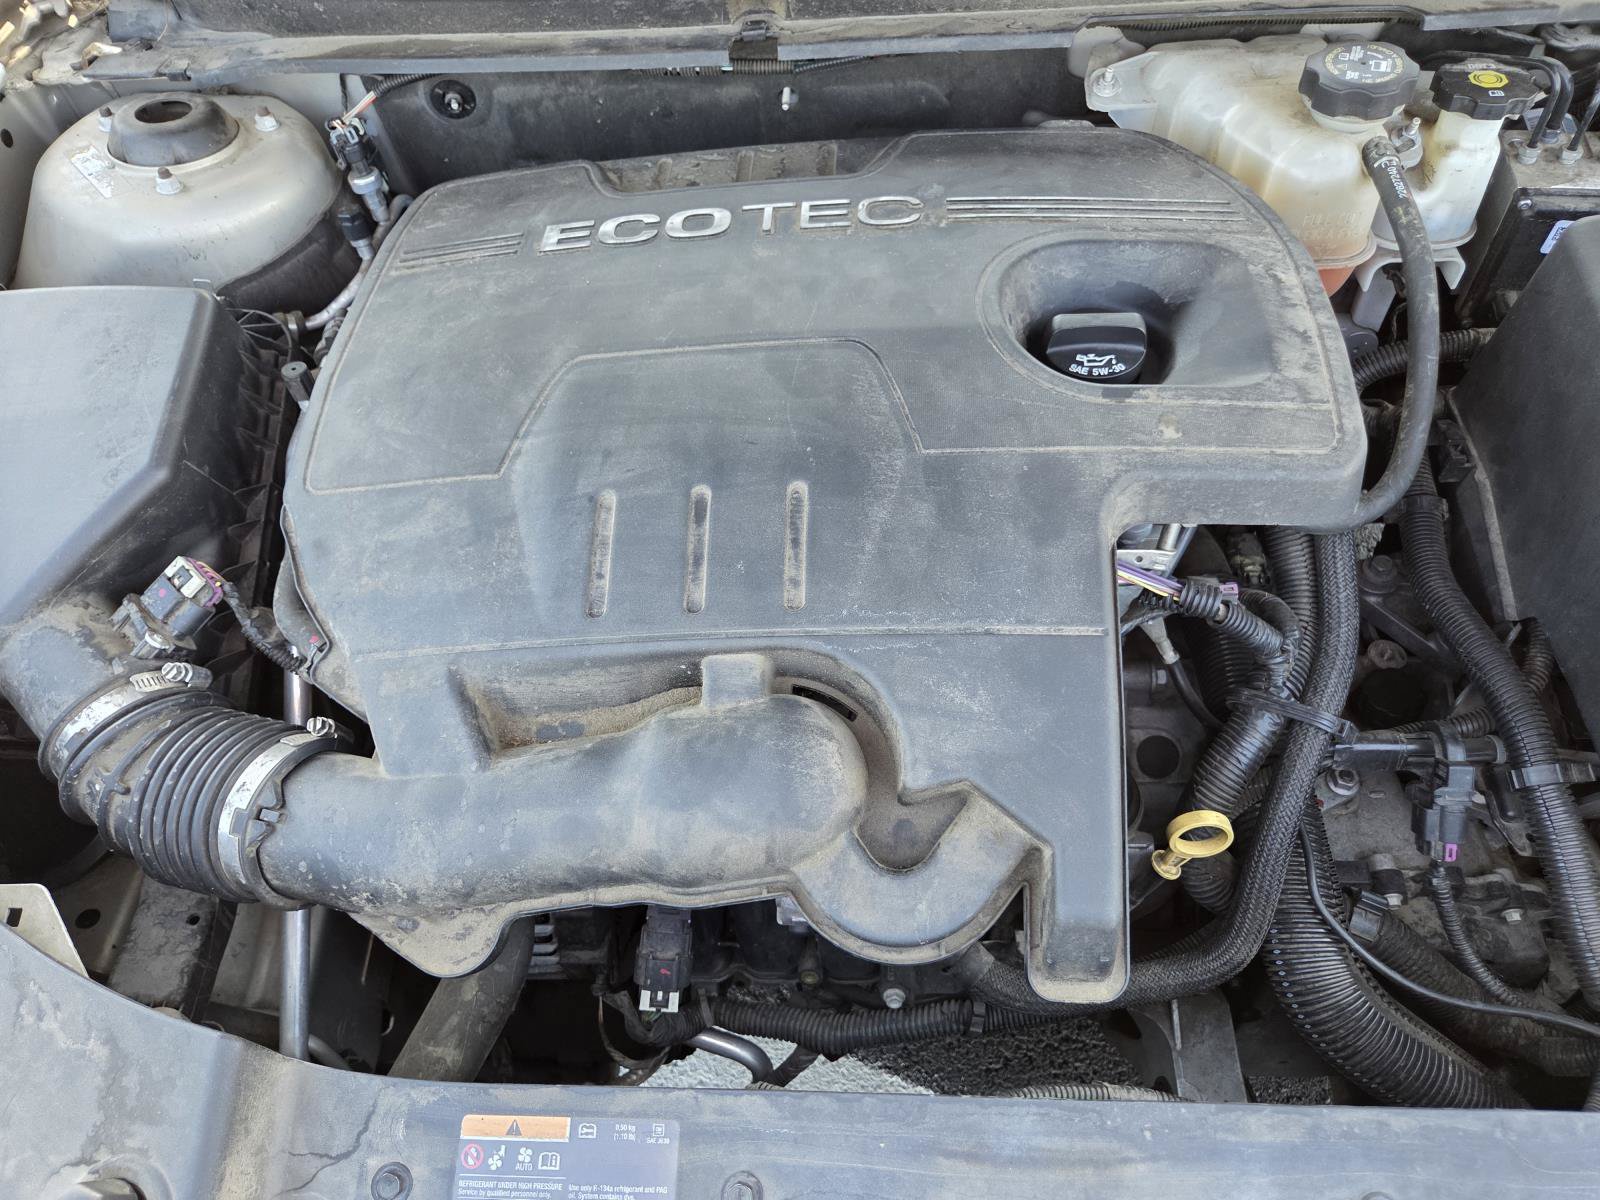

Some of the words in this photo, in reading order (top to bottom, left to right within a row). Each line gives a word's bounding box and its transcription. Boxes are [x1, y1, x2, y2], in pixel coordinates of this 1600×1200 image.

[541, 195, 924, 253] ECOTEC
[1069, 363, 1089, 376] SAE
[1092, 363, 1126, 376] 5W-30
[515, 1162, 533, 1171] AUTO
[458, 1180, 497, 1188] REFRIGERANT
[498, 1181, 518, 1189] UNDER
[533, 1182, 563, 1190] PRESSURE
[580, 1184, 592, 1192] only
[593, 1184, 613, 1192] R-134a
[614, 1185, 644, 1193] refrigerant
[656, 1186, 668, 1194] PAG
[479, 1189, 486, 1197] by
[486, 1189, 511, 1197] qualified
[511, 1190, 538, 1198] personnel
[577, 1192, 598, 1200] System
